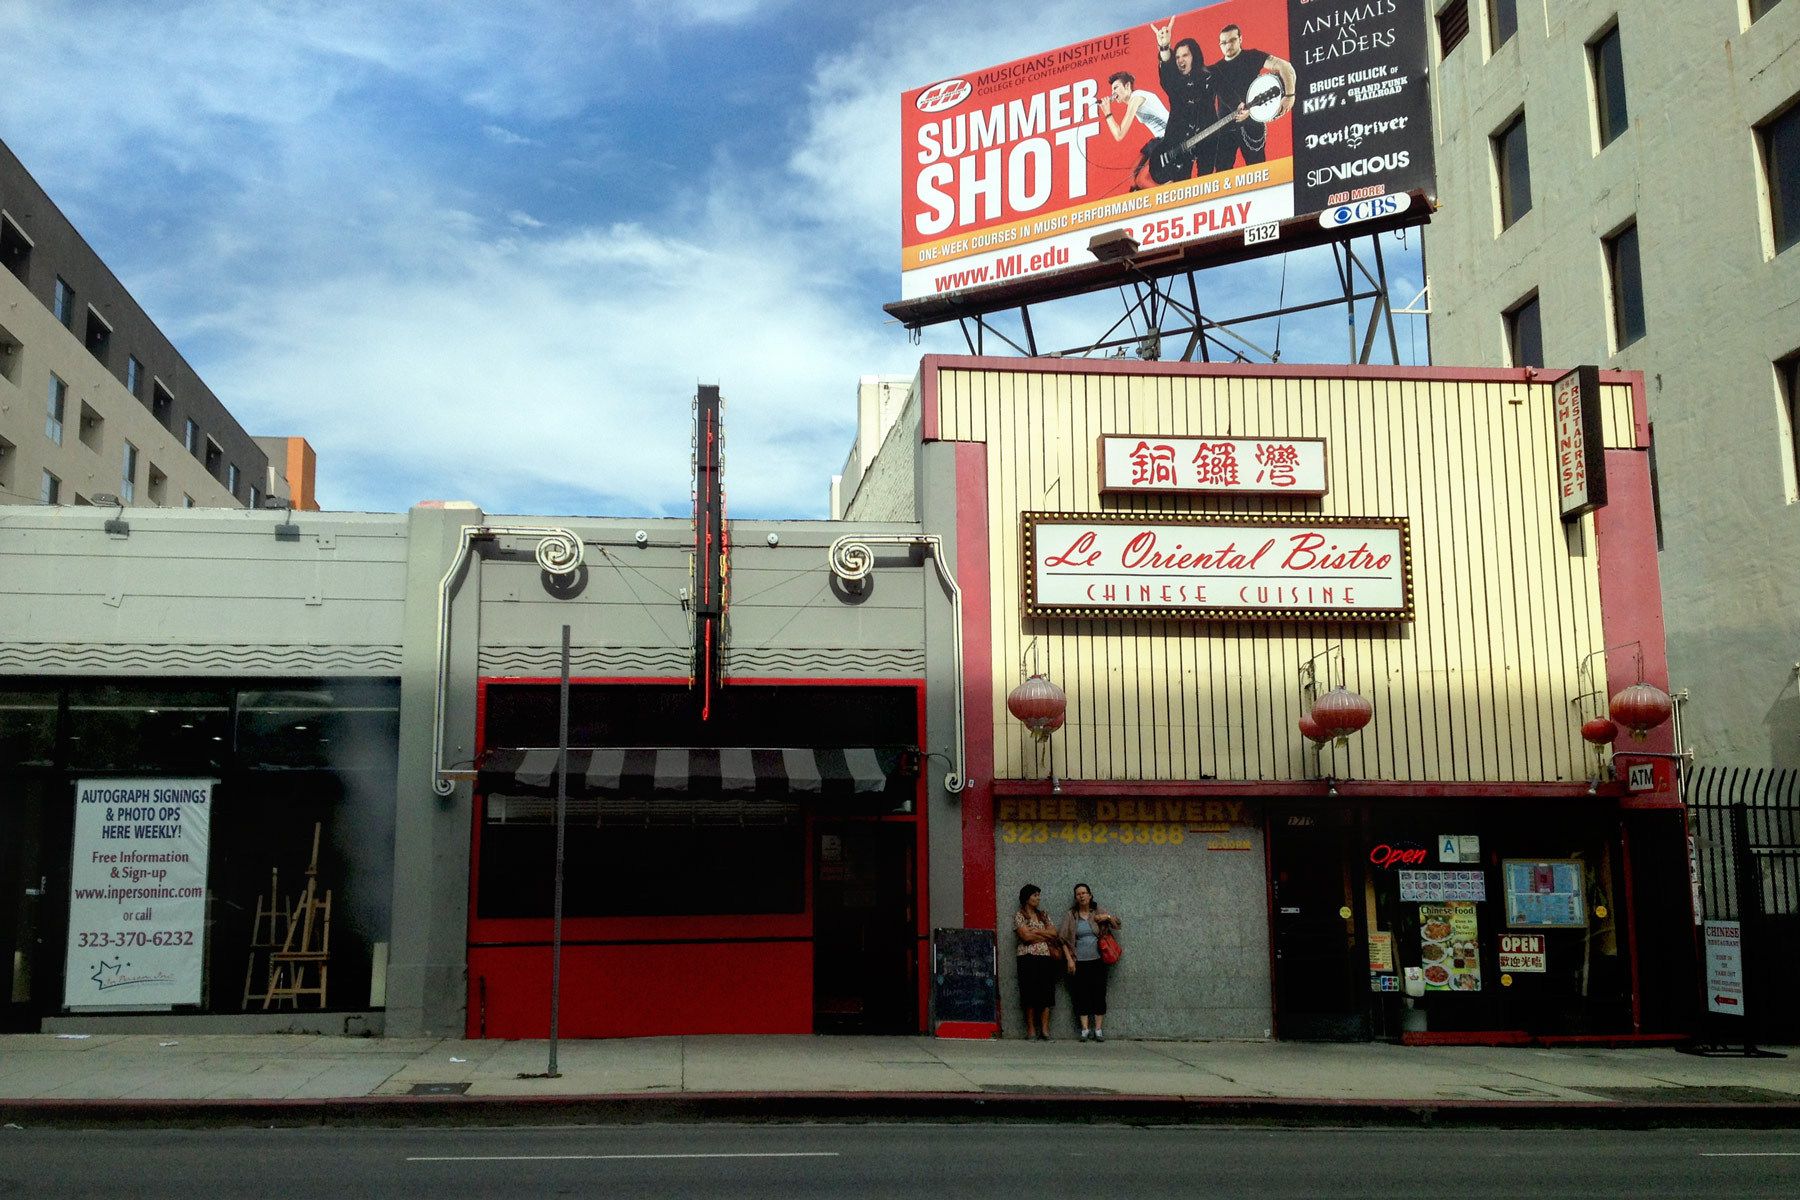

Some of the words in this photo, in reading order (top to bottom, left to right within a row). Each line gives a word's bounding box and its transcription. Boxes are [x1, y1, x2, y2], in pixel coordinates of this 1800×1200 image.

[1301, 0, 1396, 36] ANIMALS
[1337, 24, 1358, 41] AS
[1305, 28, 1396, 66] LEADERS
[977, 55, 1054, 87] MUSICIANS
[1058, 32, 1130, 64] INSTITUTE
[977, 82, 1014, 97] COLLEGE
[1015, 78, 1027, 88] OF
[1028, 57, 1099, 83] CONTEMPORARY
[1101, 46, 1130, 61] MUSIC
[1309, 75, 1346, 95] BRUCE
[1347, 65, 1387, 85] KULICK
[1390, 66, 1399, 75] OF
[1347, 82, 1381, 97] GRAND
[1381, 76, 1408, 89] FUNK
[1354, 85, 1402, 102] RAILROAD
[1303, 92, 1337, 115] KISS
[917, 78, 1100, 164] SUMMER
[915, 121, 1100, 235] SHOT
[1327, 190, 1349, 206] AND
[1351, 184, 1385, 200] MORE!
[919, 240, 969, 262] ONE-WEEK
[971, 230, 1017, 251] COURSES
[1020, 225, 1031, 238] IN
[1034, 215, 1068, 235] MUSIC
[1071, 196, 1152, 225] PERFORMANCE,
[1155, 178, 1220, 205] RECORDING
[1223, 177, 1232, 190] &
[1235, 170, 1270, 187] MORE
[1355, 196, 1397, 220] CBS
[1248, 225, 1277, 242] 5132
[935, 245, 1069, 293] www.MI.edu
[1558, 391, 1574, 499] CHINESE
[1570, 385, 1585, 492] RESTAURANT
[1129, 441, 1300, 487] 銅鑼灣
[1044, 530, 1102, 568] Le
[1121, 530, 1276, 570] Oriental
[1281, 532, 1393, 571] Bistro
[1087, 583, 1207, 603] CHINESE
[1239, 585, 1356, 604] CUISINE
[1631, 768, 1653, 786] ATM
[81, 789, 150, 804] AUTOGRAPH
[153, 788, 206, 803] SIGNINGS
[106, 808, 114, 821] &
[117, 807, 155, 821] PHOTO
[159, 807, 181, 821] OPS
[1000, 799, 1078, 821] FREE
[1095, 799, 1244, 822] DELIVERY
[102, 825, 130, 839] HERE
[134, 825, 181, 839] WEEKLY!
[92, 851, 117, 863] Free
[120, 851, 189, 863] Information
[1370, 844, 1428, 869] Open
[1443, 840, 1455, 853] A
[110, 867, 119, 878] &
[122, 867, 167, 883] Sign-up
[75, 884, 202, 904] www.inpersoninc.com
[122, 911, 133, 921] or
[135, 907, 152, 921] call
[1421, 906, 1453, 915] Chinese
[78, 931, 193, 948] 323-370-6232
[1707, 926, 1740, 938] CHINESE
[1502, 936, 1539, 953] OPEN
